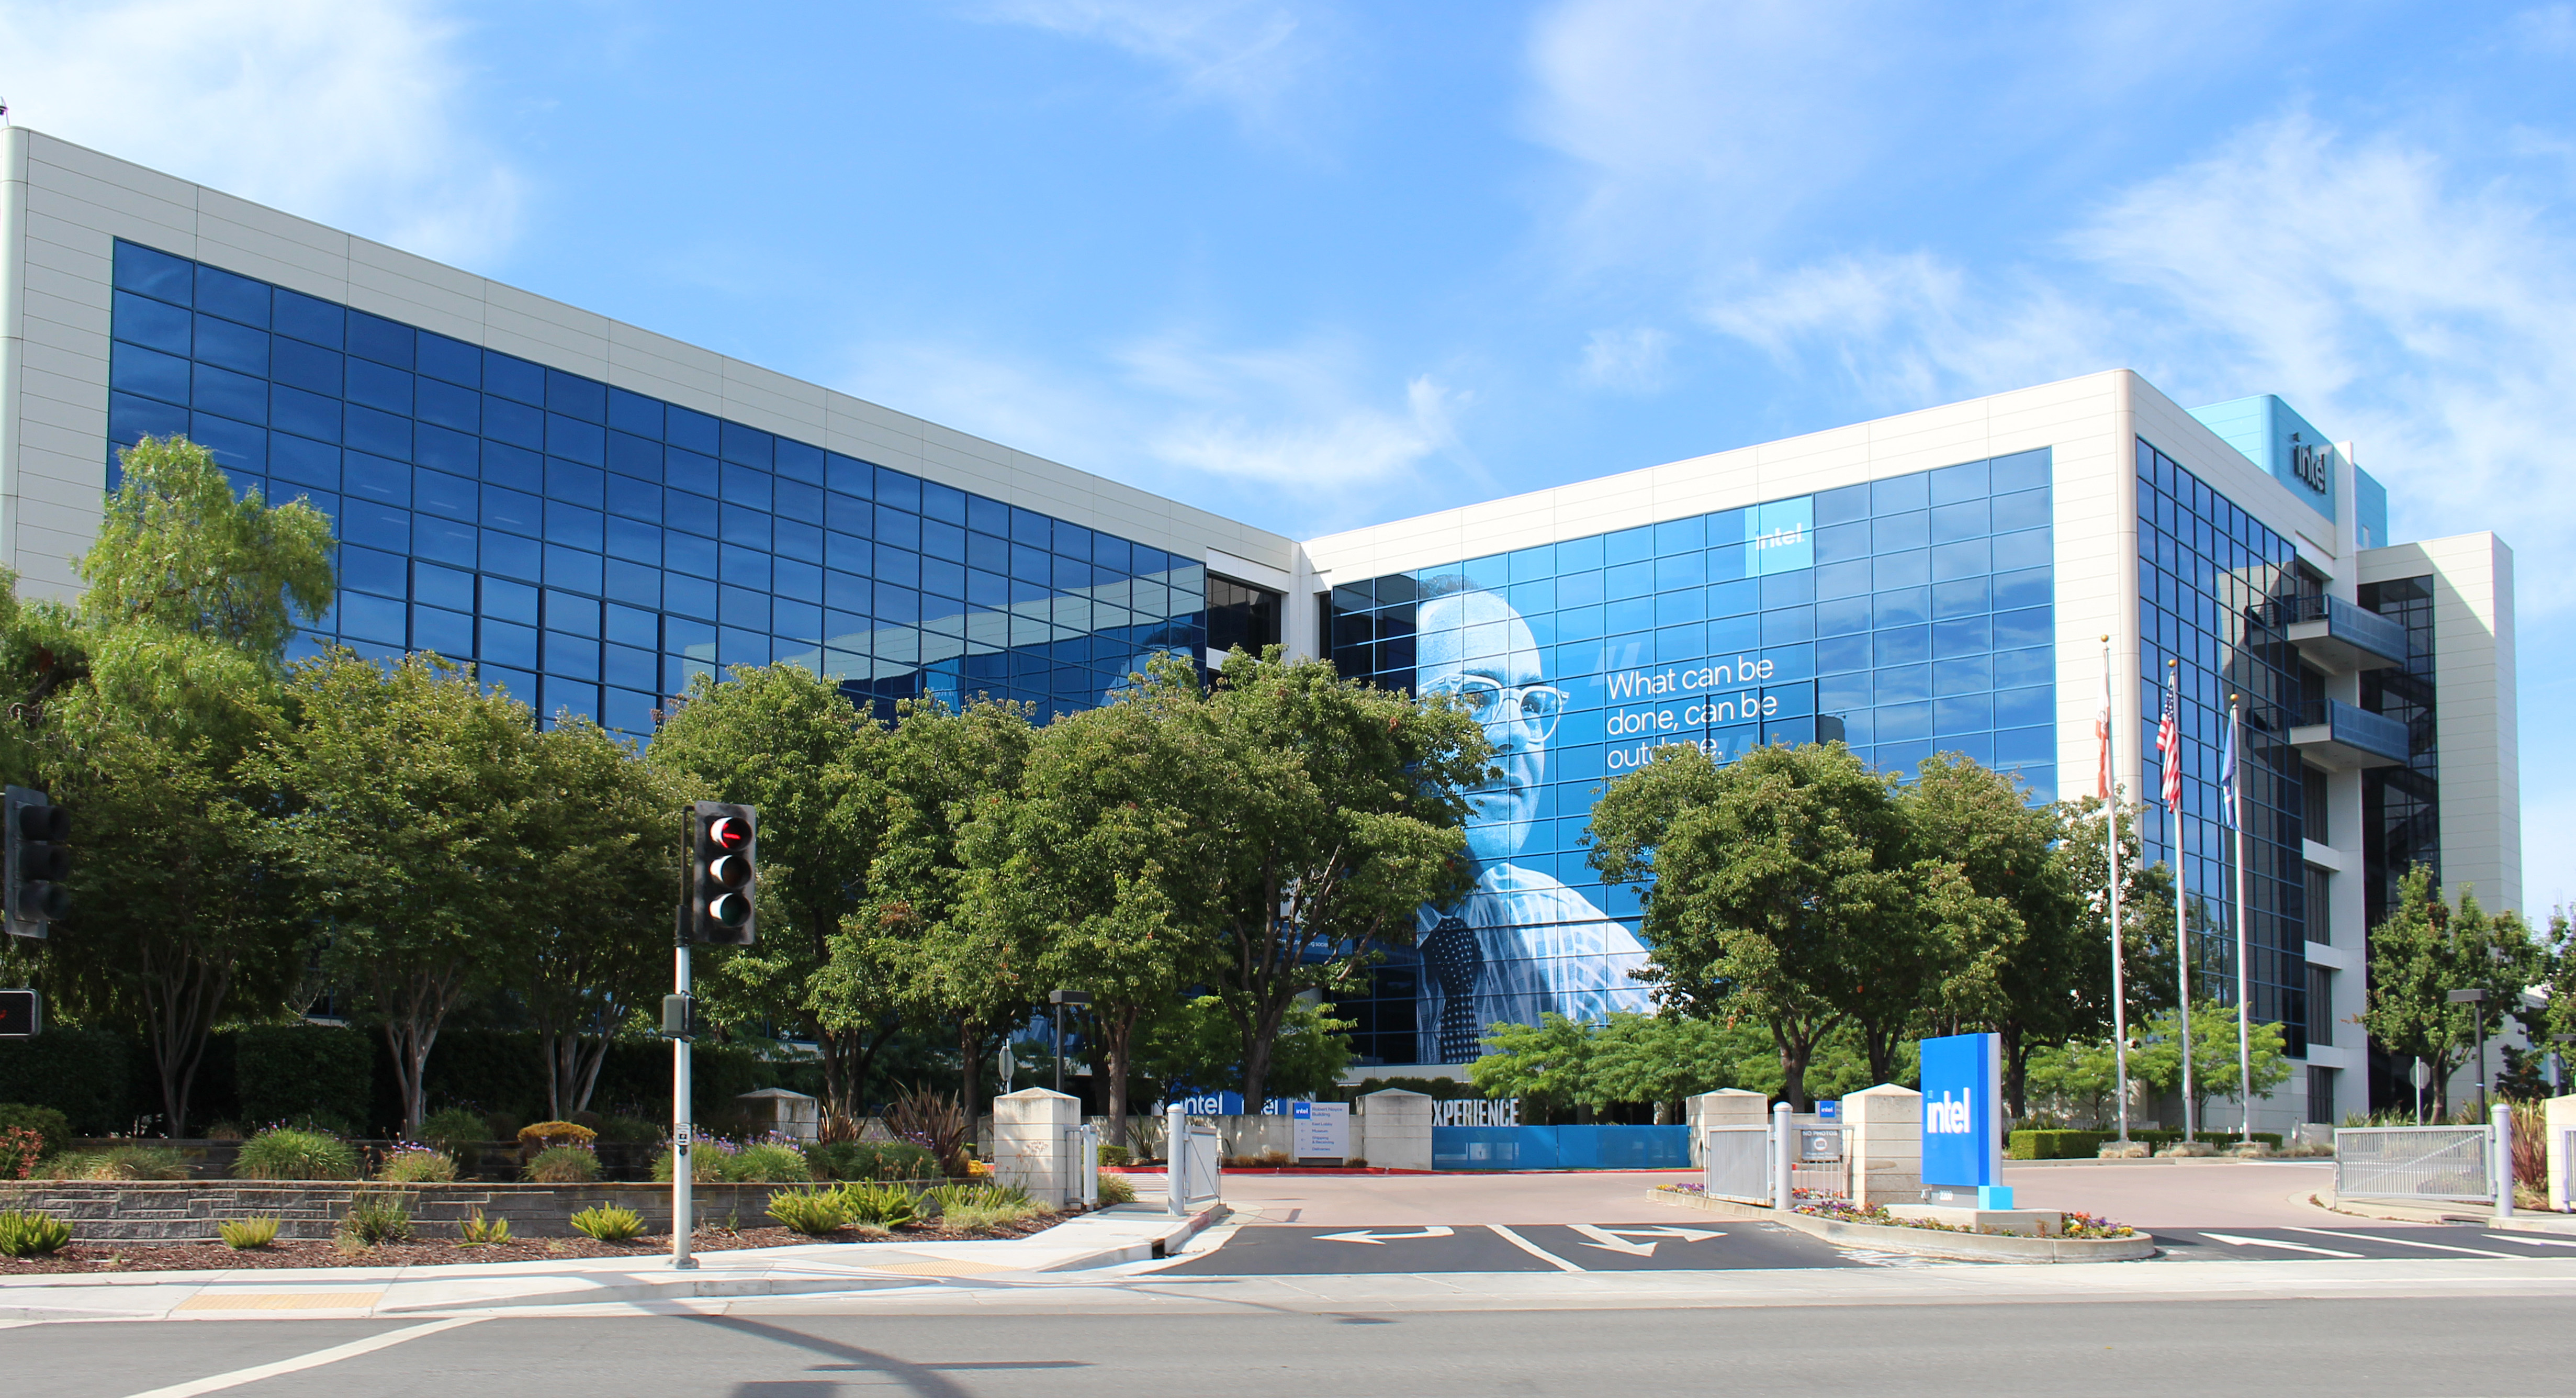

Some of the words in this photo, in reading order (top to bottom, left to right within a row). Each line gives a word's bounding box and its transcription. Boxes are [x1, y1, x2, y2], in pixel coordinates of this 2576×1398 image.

[2292, 431, 2326, 495] intel
[1607, 668, 1676, 700] What
[1682, 665, 1731, 690] can
[1738, 655, 1774, 682] be
[1607, 708, 1680, 735] done,
[1685, 701, 1735, 726] can
[1741, 691, 1778, 719] be
[1180, 1092, 1223, 1115] ntel
[1432, 1098, 1520, 1127] XPERIENCE
[1927, 1087, 1971, 1134] intel
